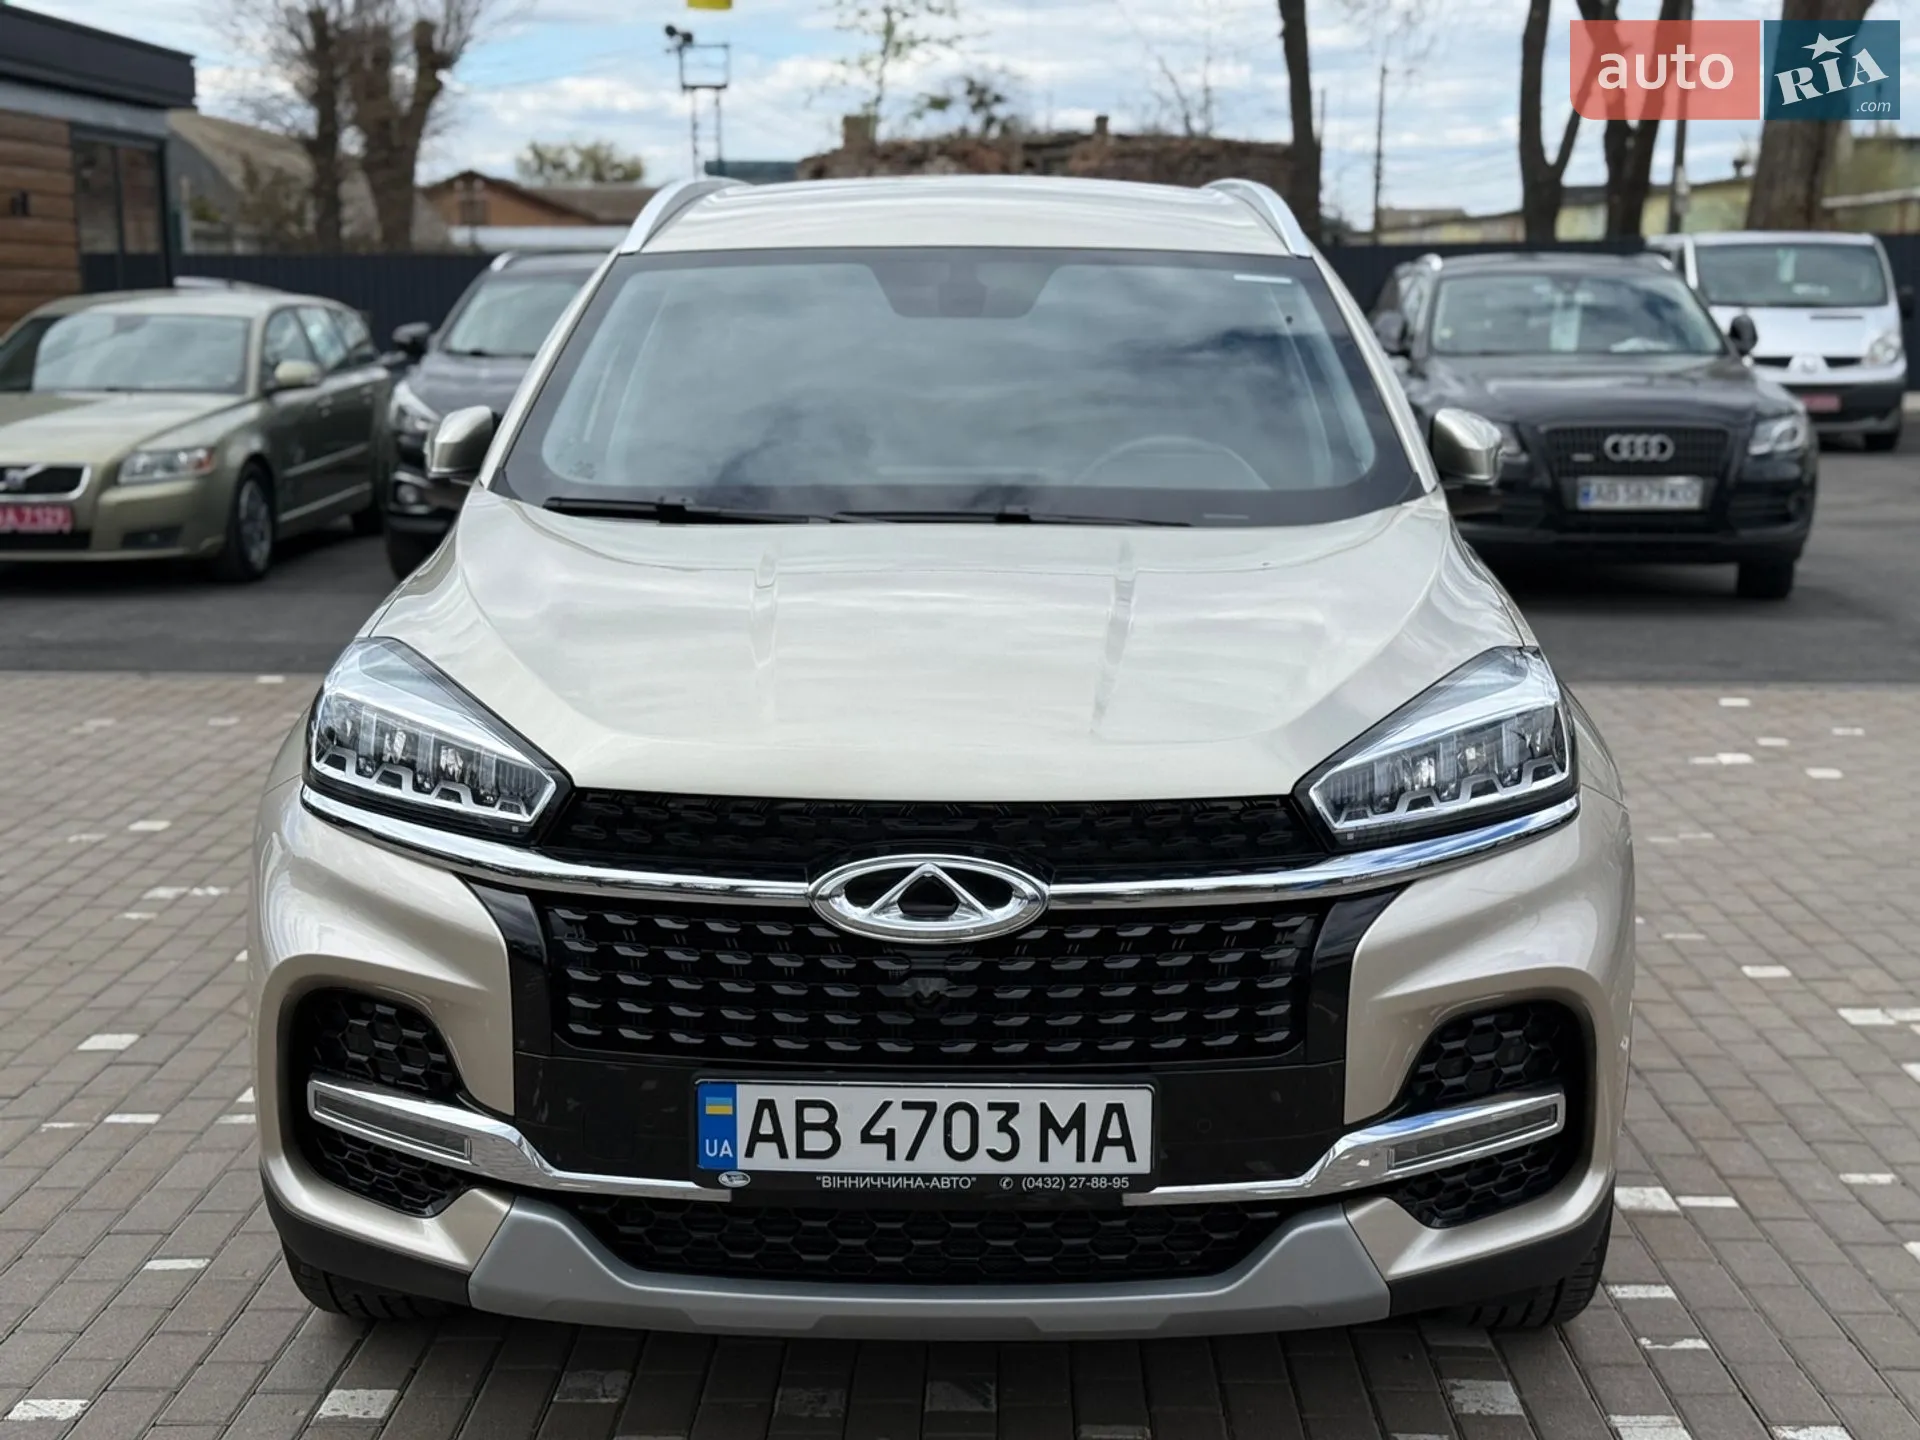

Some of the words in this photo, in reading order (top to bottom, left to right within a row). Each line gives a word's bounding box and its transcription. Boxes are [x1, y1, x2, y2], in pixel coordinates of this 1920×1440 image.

[744, 1098, 842, 1160] AB
[860, 1100, 1021, 1163] 4703
[1039, 1101, 1137, 1163] MA
[705, 1139, 733, 1158] UA
[1021, 1176, 1066, 1191] (0432)
[1069, 1176, 1130, 1189] 27-88-95
